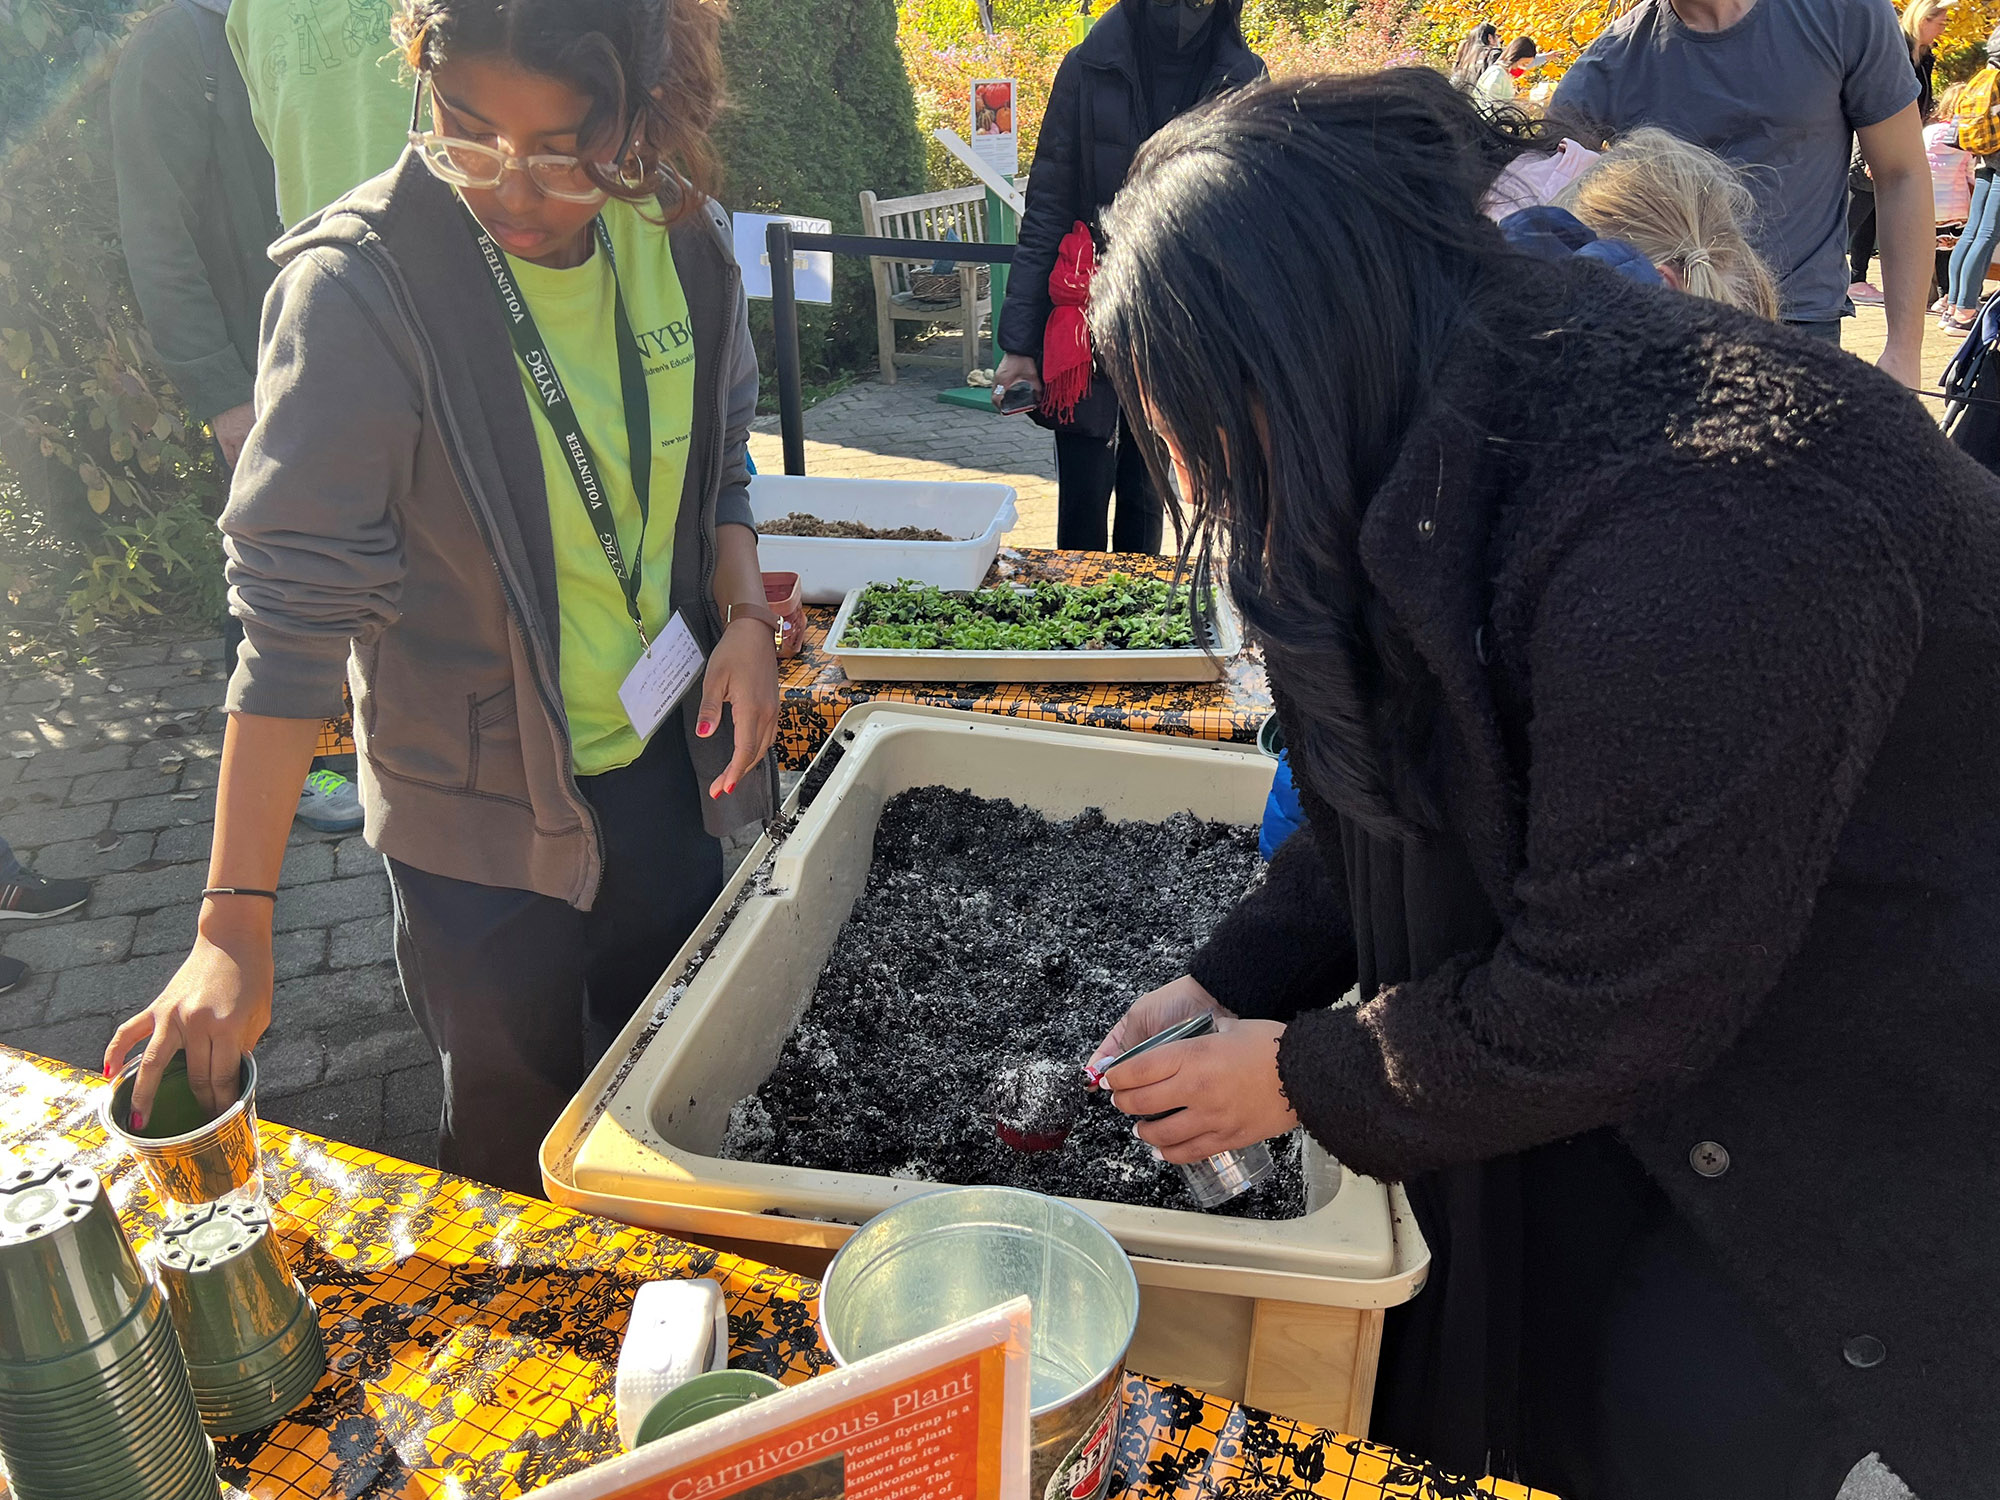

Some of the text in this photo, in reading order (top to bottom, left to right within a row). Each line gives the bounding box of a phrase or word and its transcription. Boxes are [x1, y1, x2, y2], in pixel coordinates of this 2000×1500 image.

[477, 234, 524, 324] VOLUNTEER
[525, 350, 561, 408] NYBG
[566, 432, 602, 510] VOLUNTEER
[600, 533, 626, 579] NYBG
[668, 1371, 974, 1500] Carnivorous Plant
[846, 1404, 970, 1457] Venus flytrap is a
[846, 1425, 953, 1474] flowering plant
[846, 1444, 940, 1488] known for its
[846, 1452, 960, 1500] carnivorous eat-
[925, 1470, 951, 1486] The
[938, 1481, 954, 1494] of
